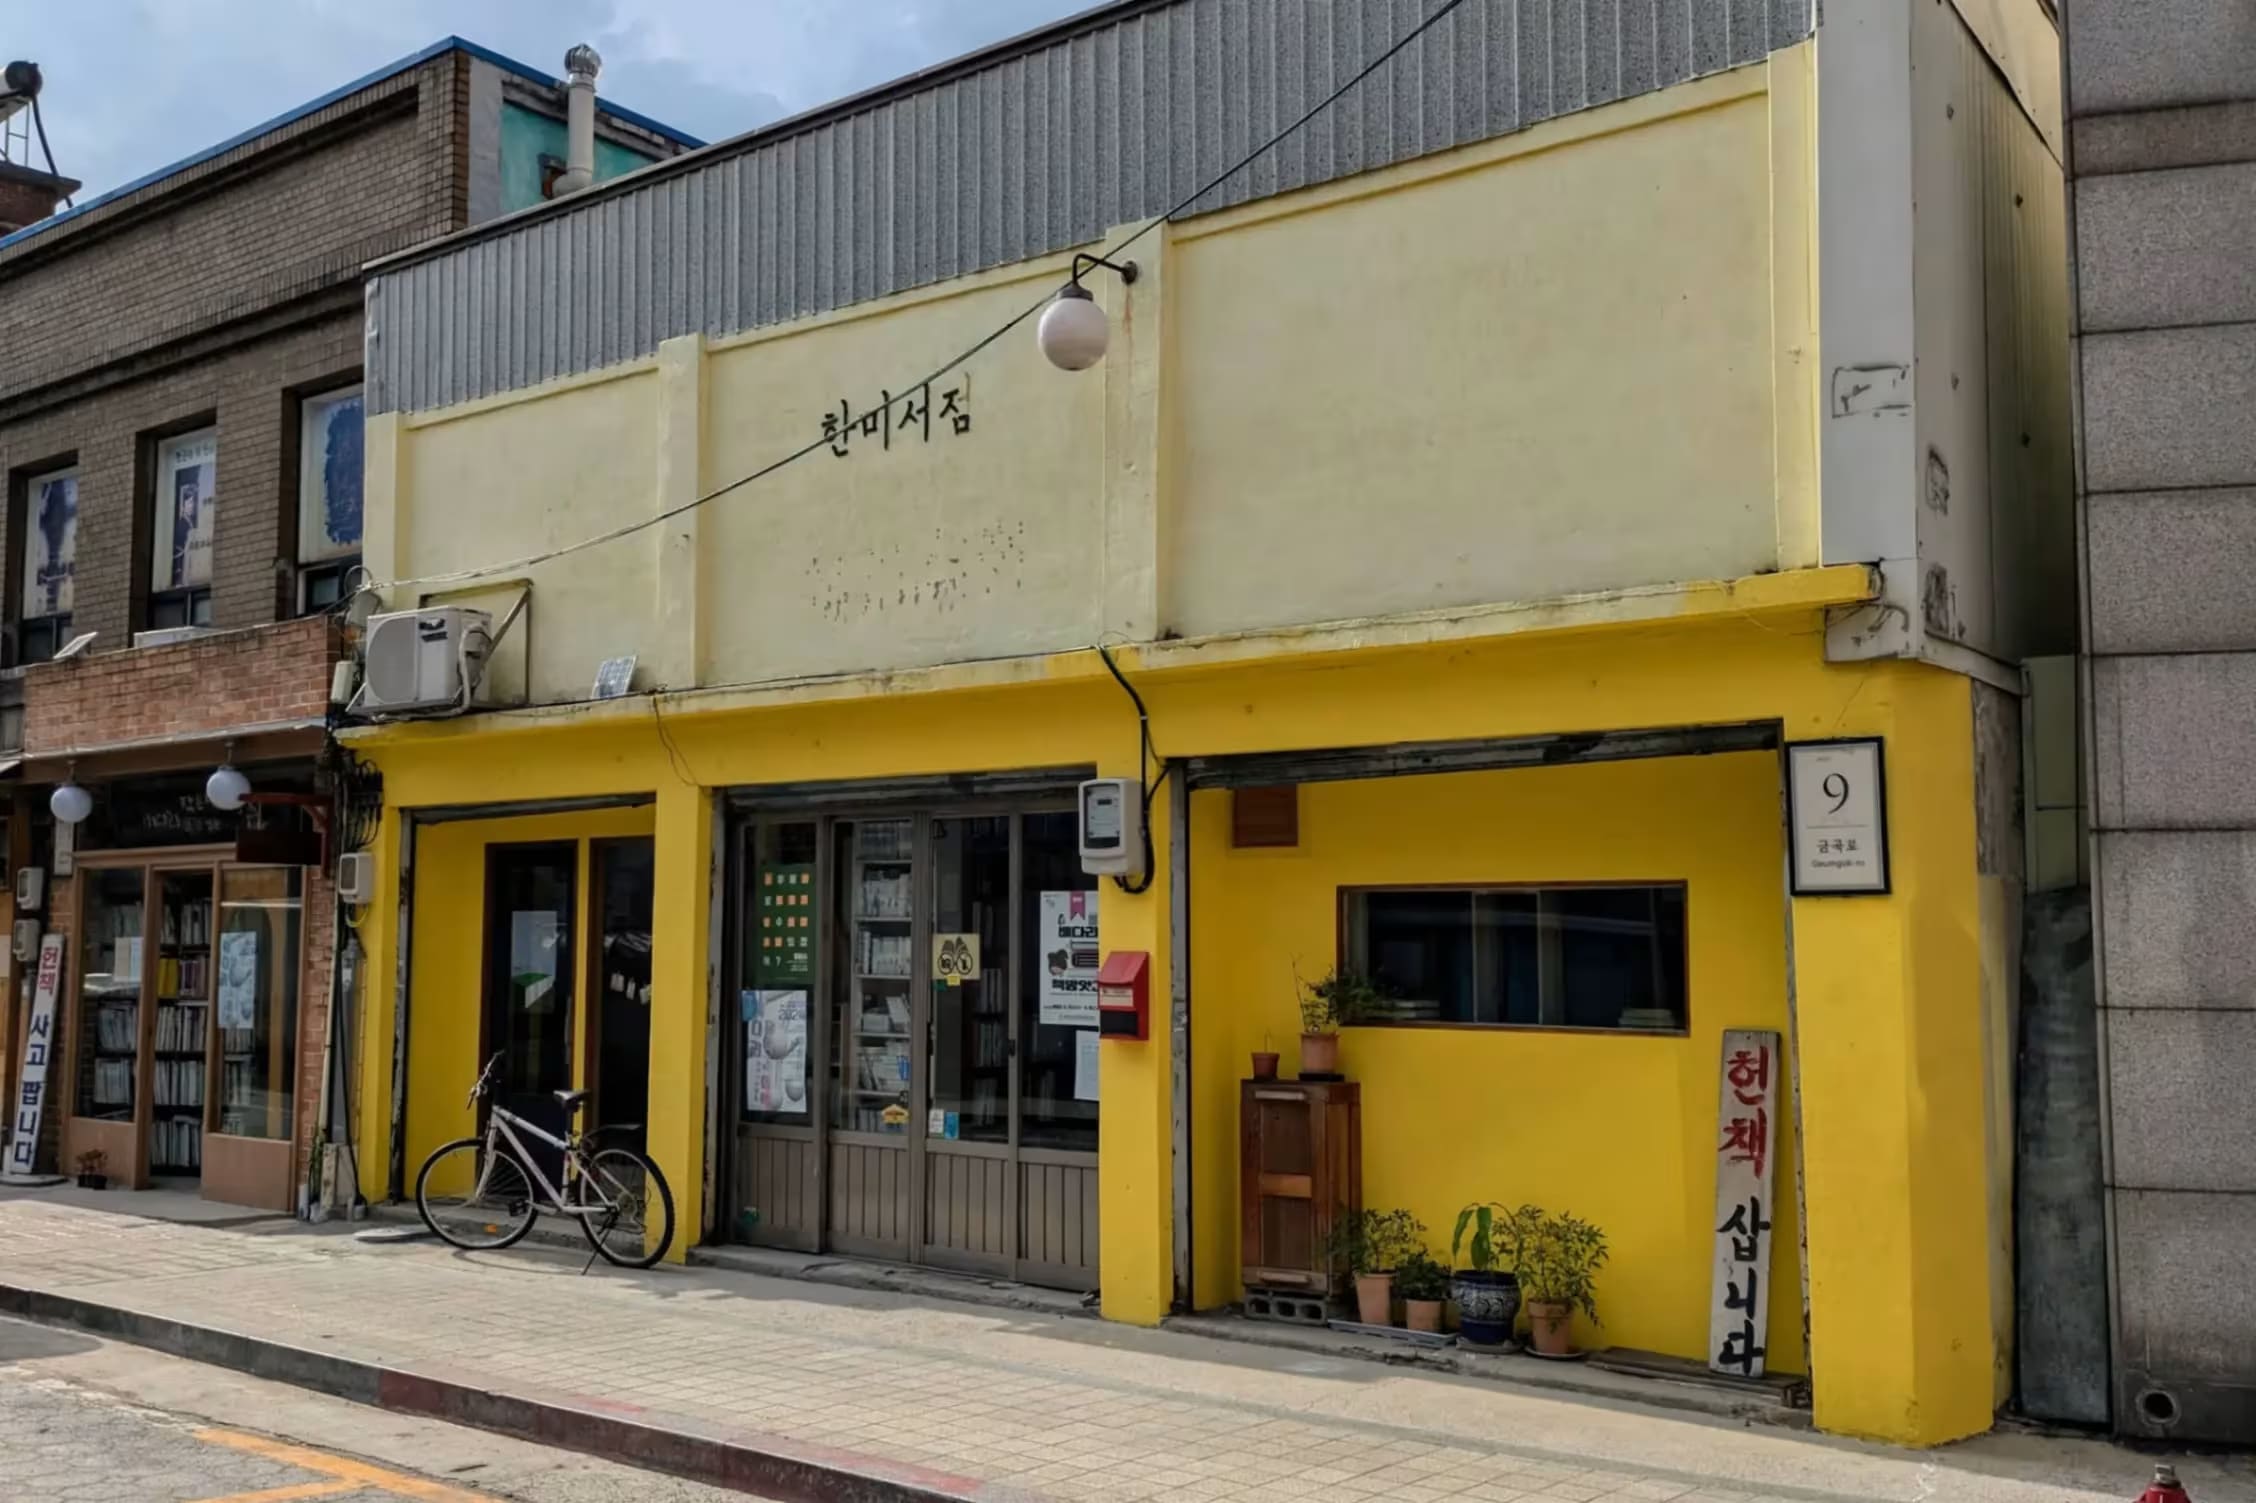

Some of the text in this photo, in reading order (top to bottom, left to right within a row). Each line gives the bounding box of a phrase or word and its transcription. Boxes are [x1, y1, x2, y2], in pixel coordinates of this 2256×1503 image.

[821, 372, 972, 457] 한미서점
[1822, 772, 1850, 815] 9
[1816, 838, 1860, 854] 금곡로
[13, 945, 62, 1166] 헌책 사고 팝니다
[1715, 1045, 1771, 1376] 헌책 삽니다
